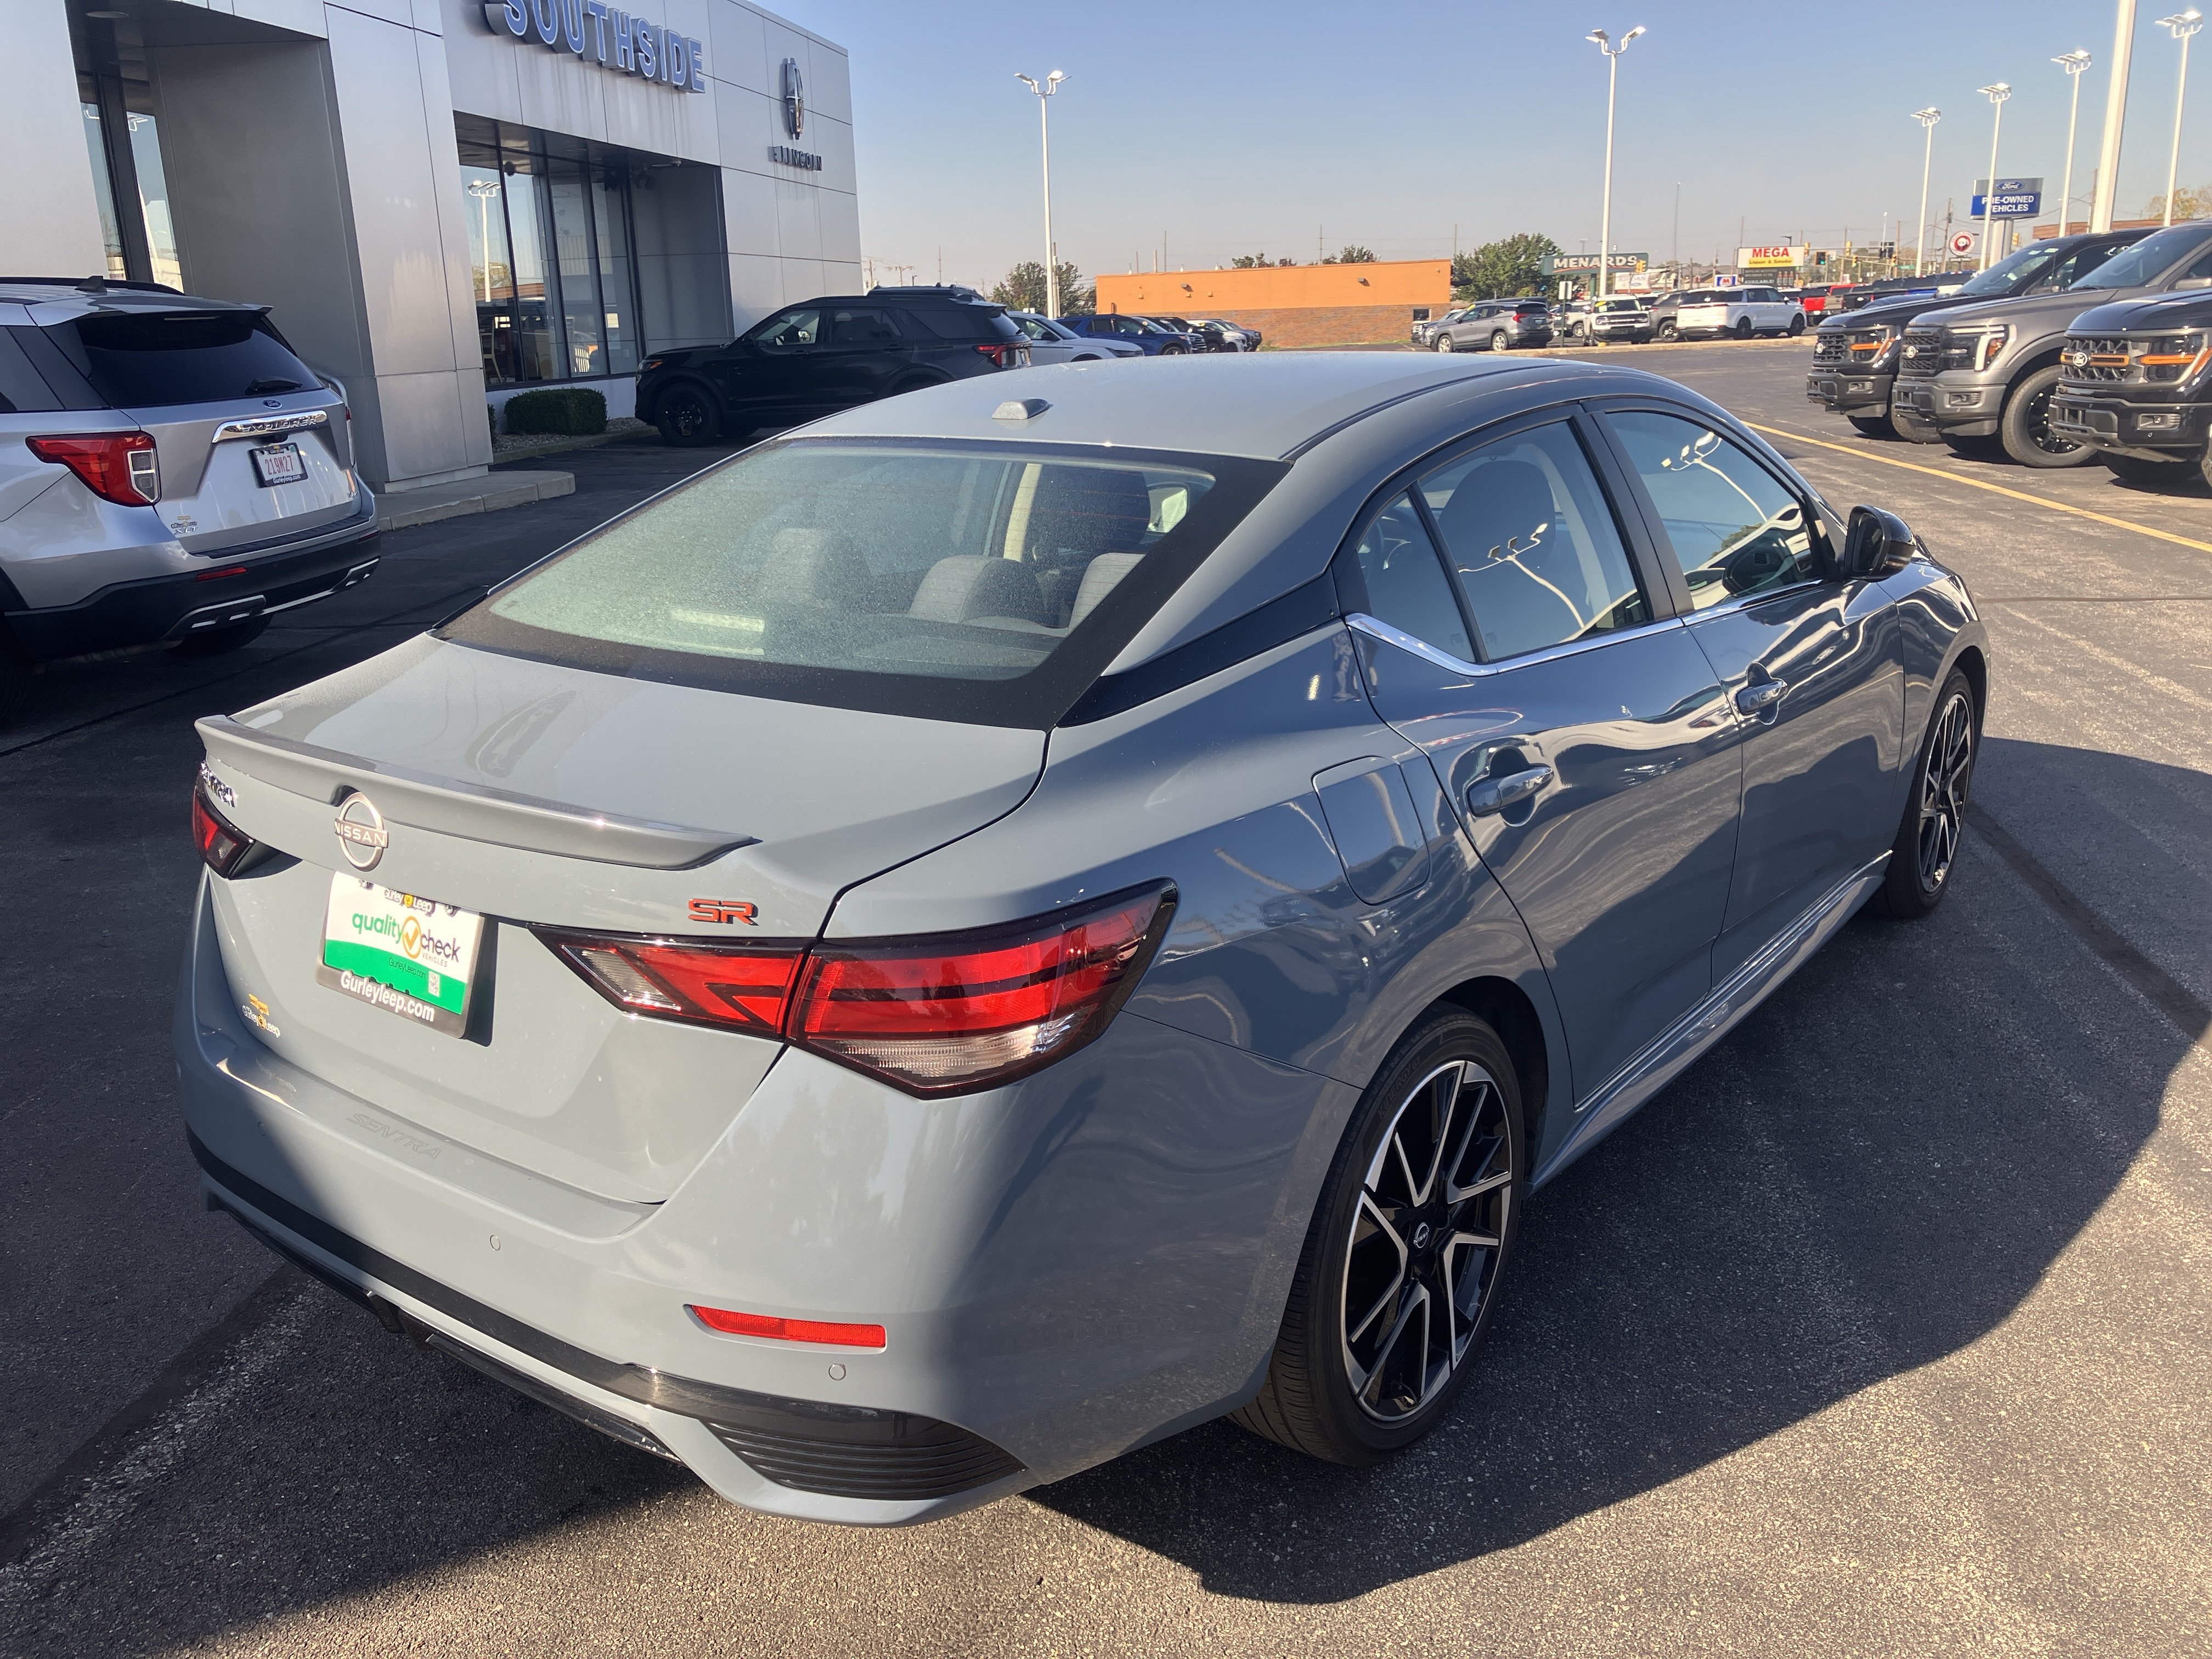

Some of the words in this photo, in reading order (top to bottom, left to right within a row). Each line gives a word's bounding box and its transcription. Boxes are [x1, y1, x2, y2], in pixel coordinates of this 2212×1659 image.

[2002, 180, 2020, 190] Ford
[1982, 195, 2035, 205] PE-OWNED
[1991, 204, 2029, 213] EHICLES
[1752, 247, 1790, 258] MEGA
[1553, 256, 1638, 269] MENARDS
[240, 418, 317, 433] EXPLORER
[174, 526, 198, 535] XLT
[335, 821, 385, 846] NISSAN
[413, 896, 433, 915] Leep
[688, 898, 755, 925] SR
[352, 912, 405, 944] quality
[421, 929, 461, 963] check
[422, 952, 448, 968] VEHICLES
[340, 969, 435, 1022] Gurleyleep.com
[1377, 1068, 1413, 1119] KINERGY
[346, 1113, 441, 1160] SENTRA
